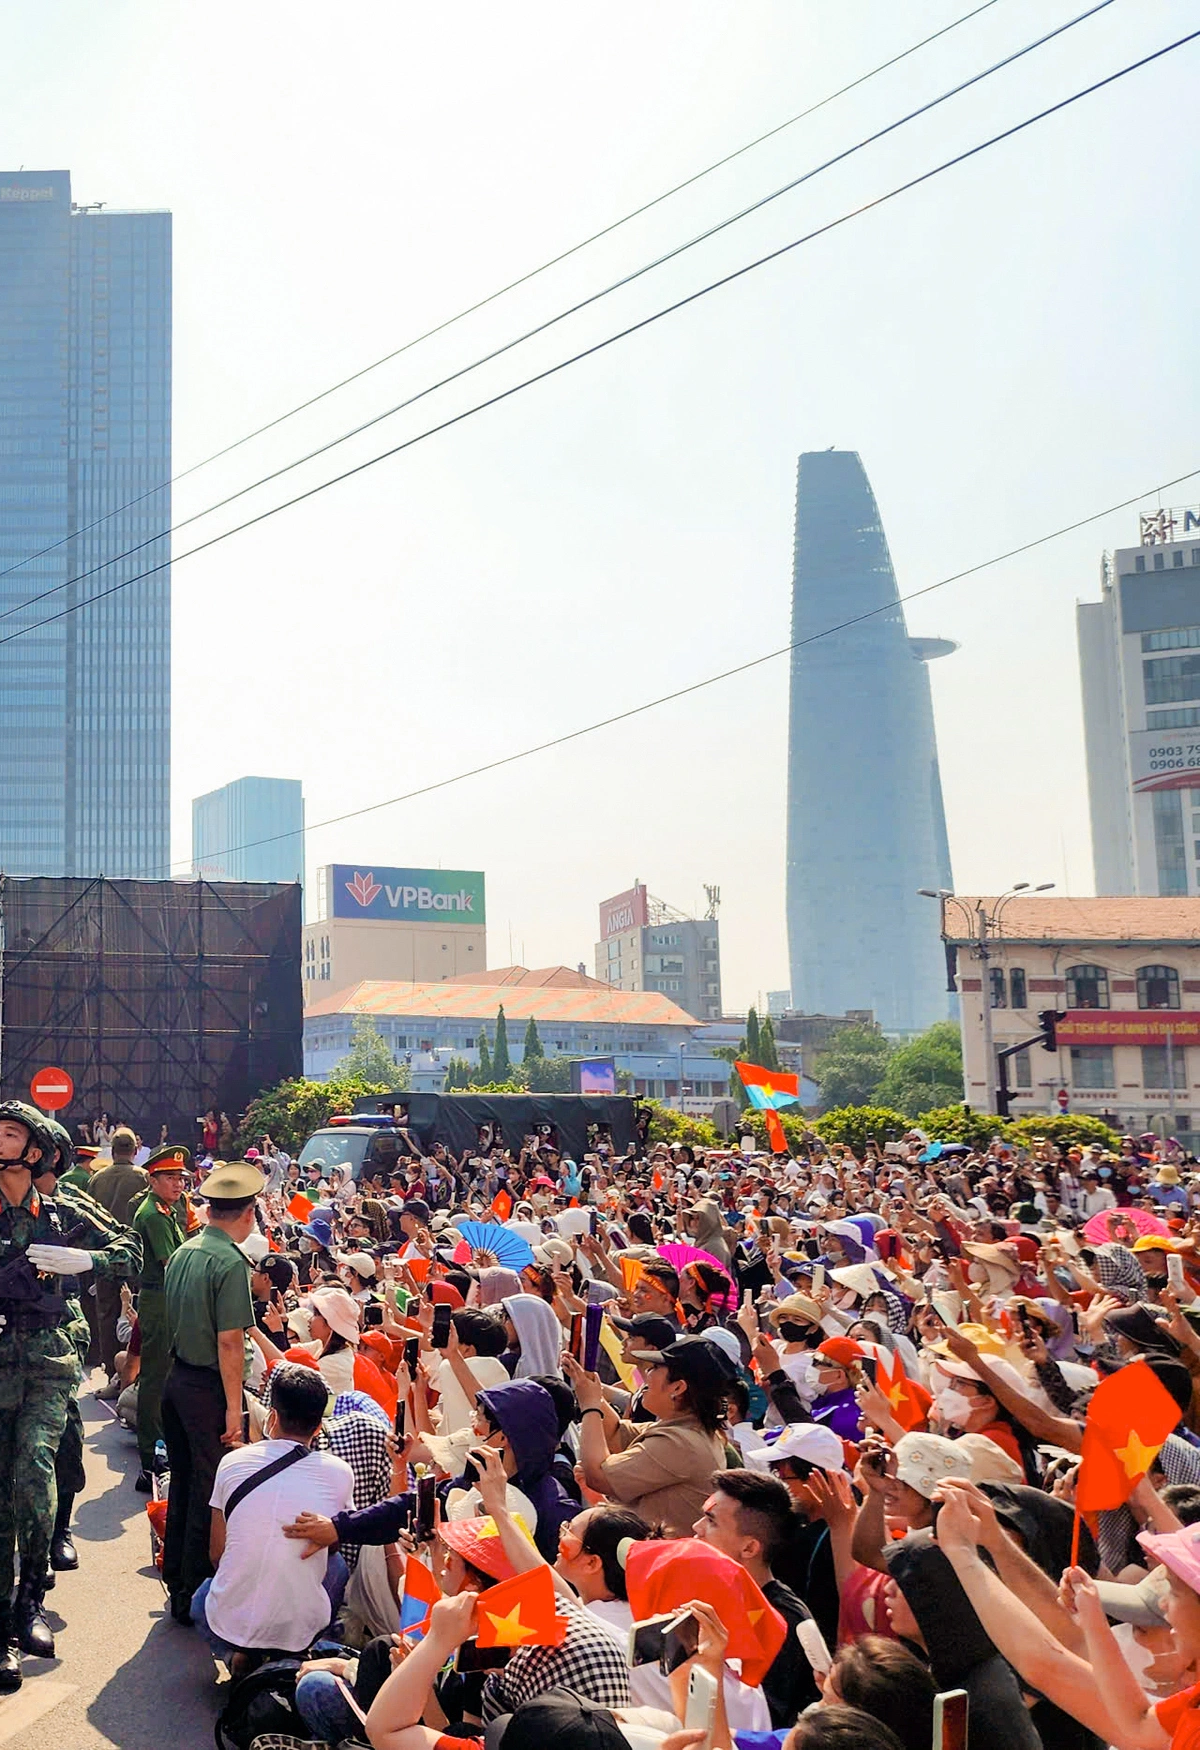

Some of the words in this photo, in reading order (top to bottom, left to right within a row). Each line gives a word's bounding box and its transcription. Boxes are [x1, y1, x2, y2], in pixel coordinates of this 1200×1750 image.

[1, 186, 53, 201] Keppel
[1149, 746, 1182, 758] 0903
[1150, 758, 1184, 770] 0906
[385, 885, 474, 911] VPBank
